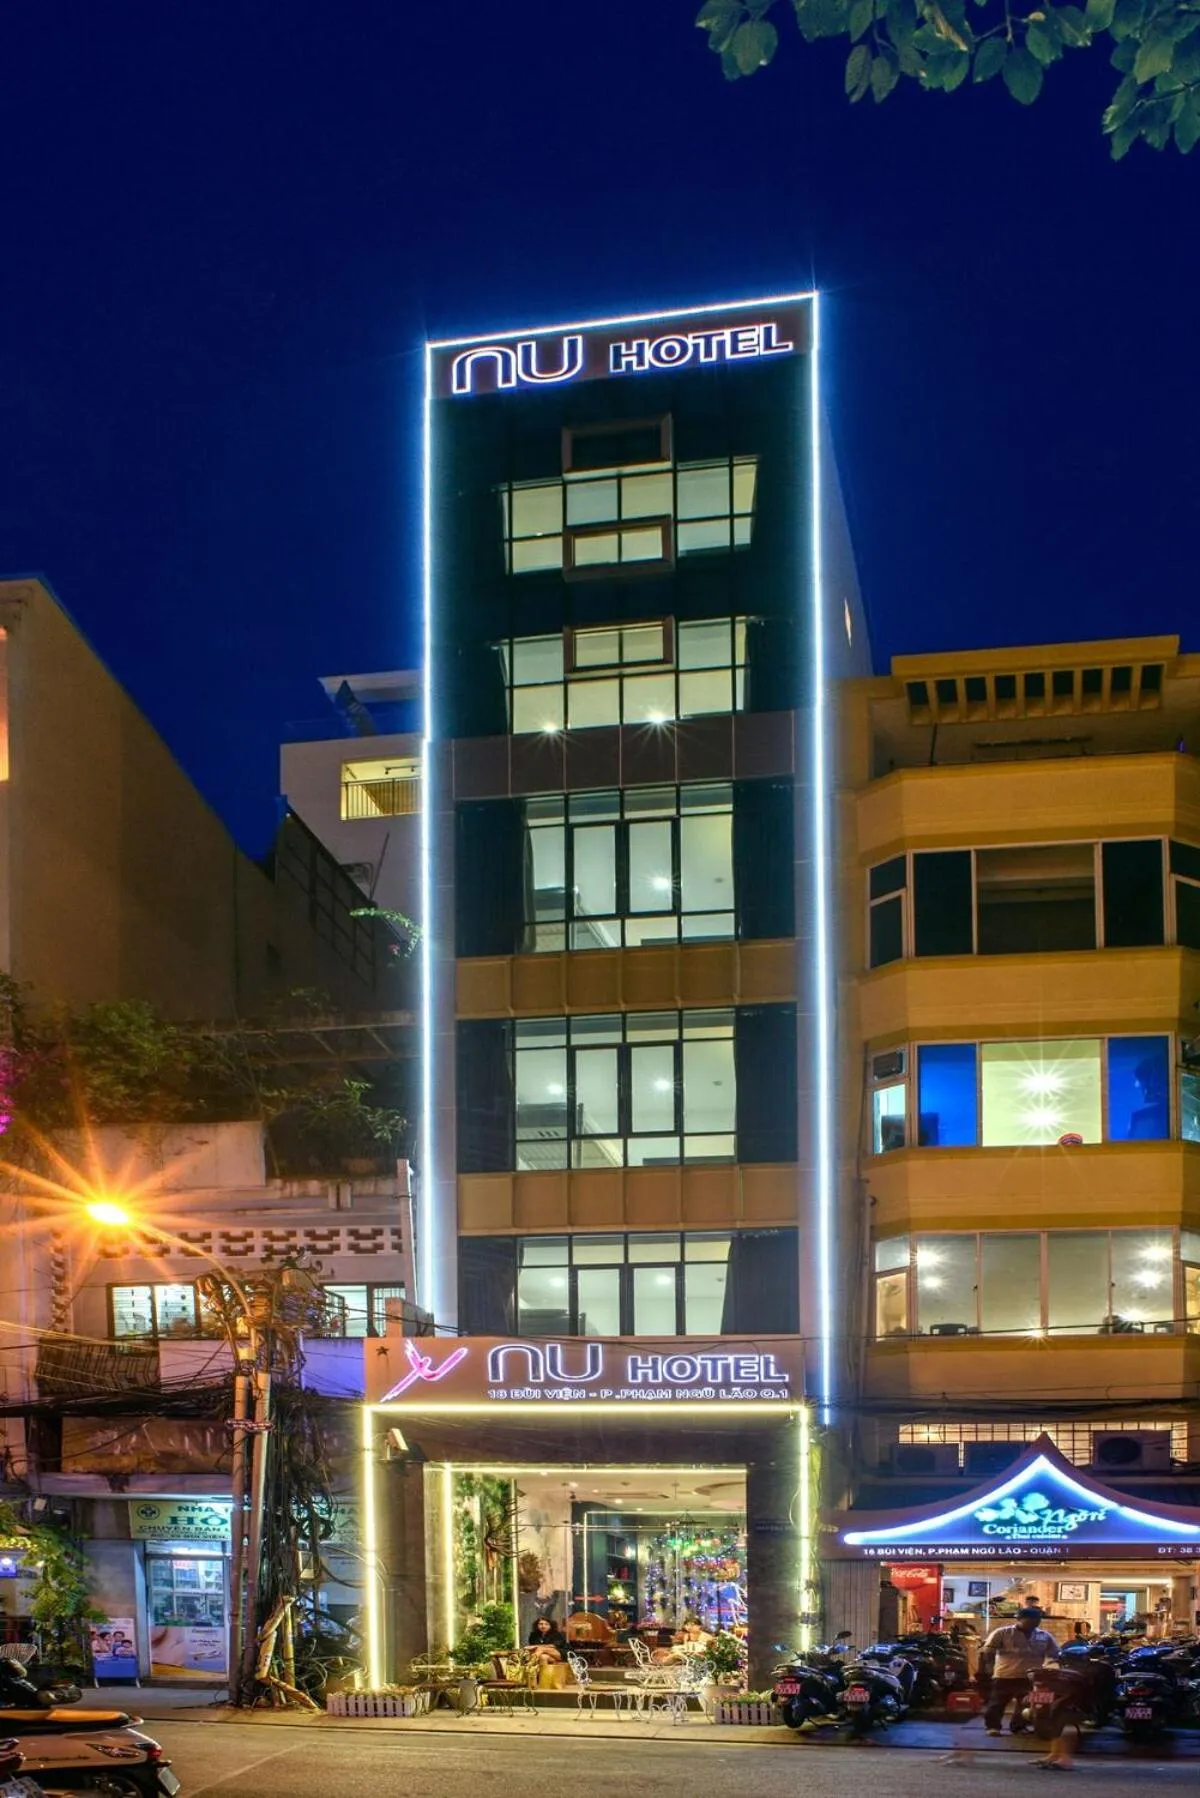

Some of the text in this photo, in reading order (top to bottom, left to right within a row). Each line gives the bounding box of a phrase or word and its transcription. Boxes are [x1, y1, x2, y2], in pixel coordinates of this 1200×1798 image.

[609, 321, 793, 372] HOTEL
[627, 1354, 790, 1383] HOTEL
[510, 1387, 541, 1399] BÙI
[676, 1386, 715, 1399] NGŨ
[719, 1386, 757, 1399] LÃO
[983, 1523, 1064, 1535] Coriander
